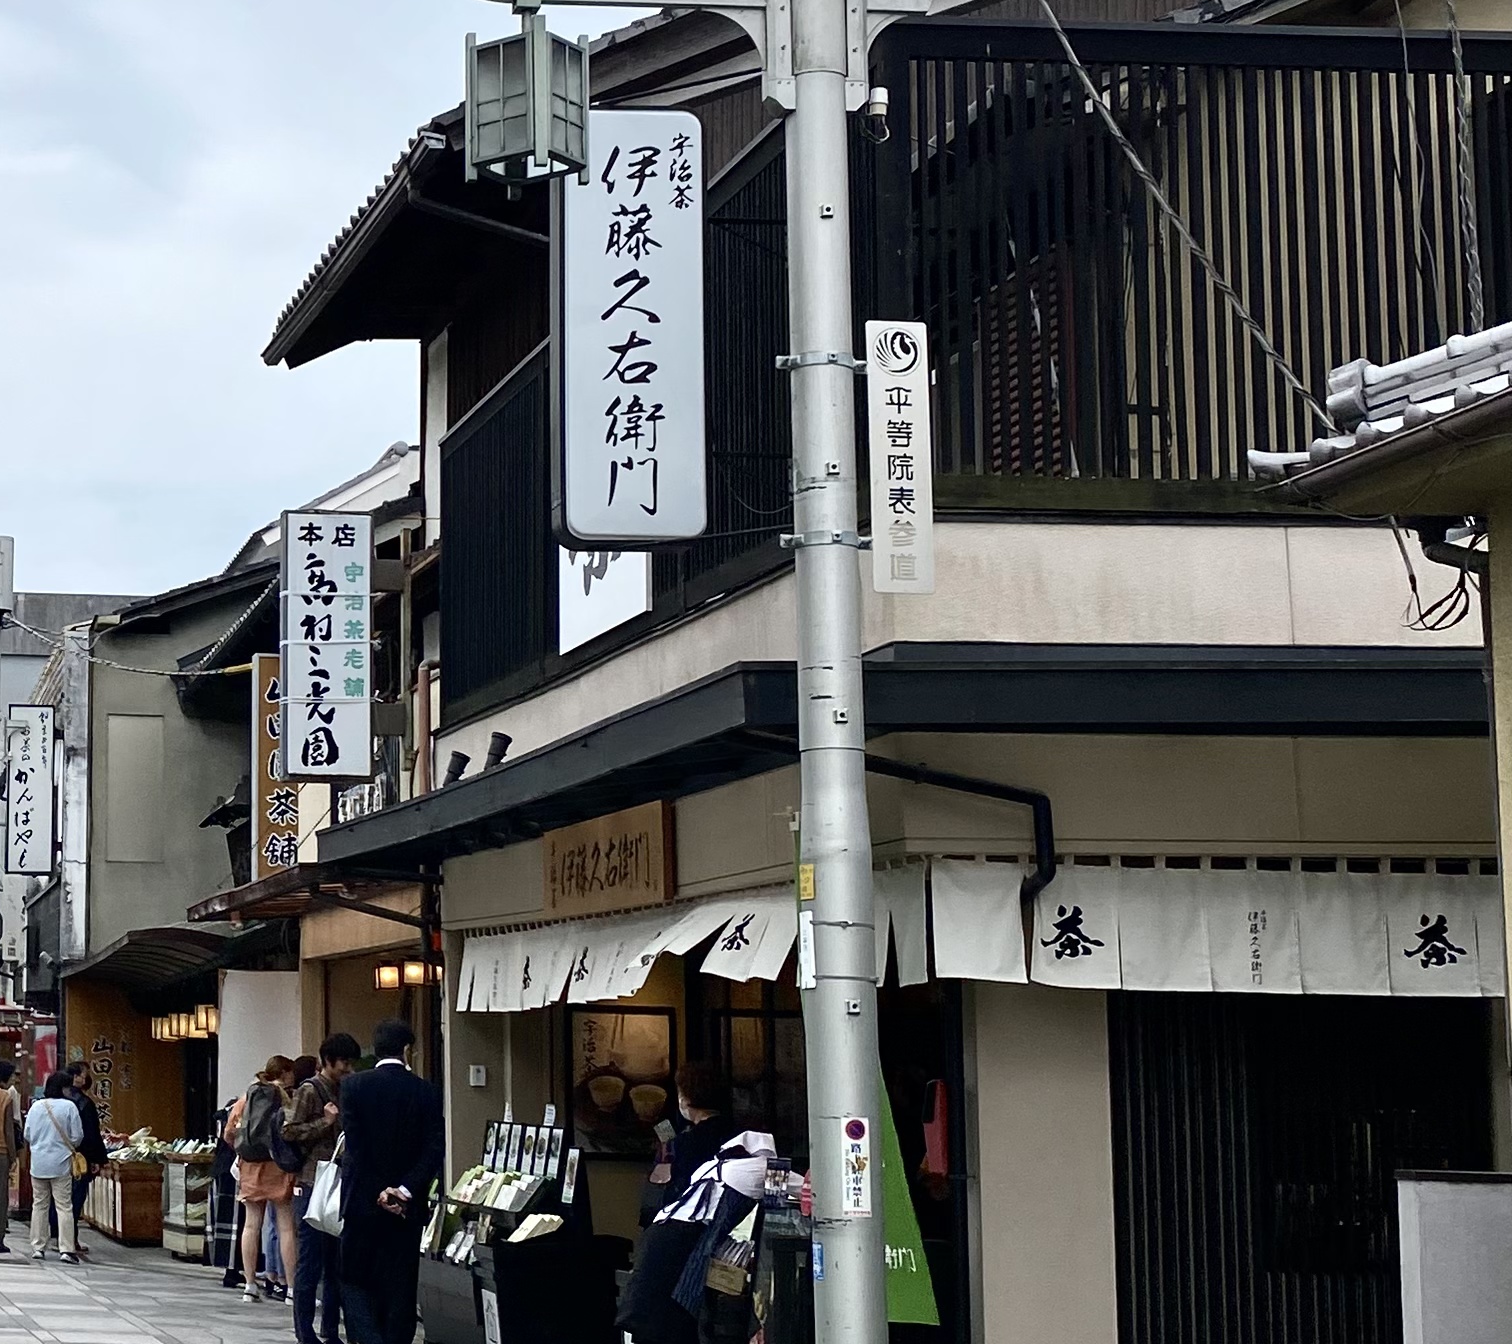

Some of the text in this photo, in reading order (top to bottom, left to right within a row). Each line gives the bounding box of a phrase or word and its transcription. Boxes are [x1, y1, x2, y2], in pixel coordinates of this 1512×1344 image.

[669, 132, 694, 209] 宇治茶
[601, 145, 666, 516] 伊藤久右衛門
[885, 386, 919, 581] 平等院表参道
[298, 522, 356, 548] 本店
[344, 561, 365, 698] 宇治茶老舗
[1041, 905, 1105, 961] 茶
[1404, 914, 1467, 970] 茶
